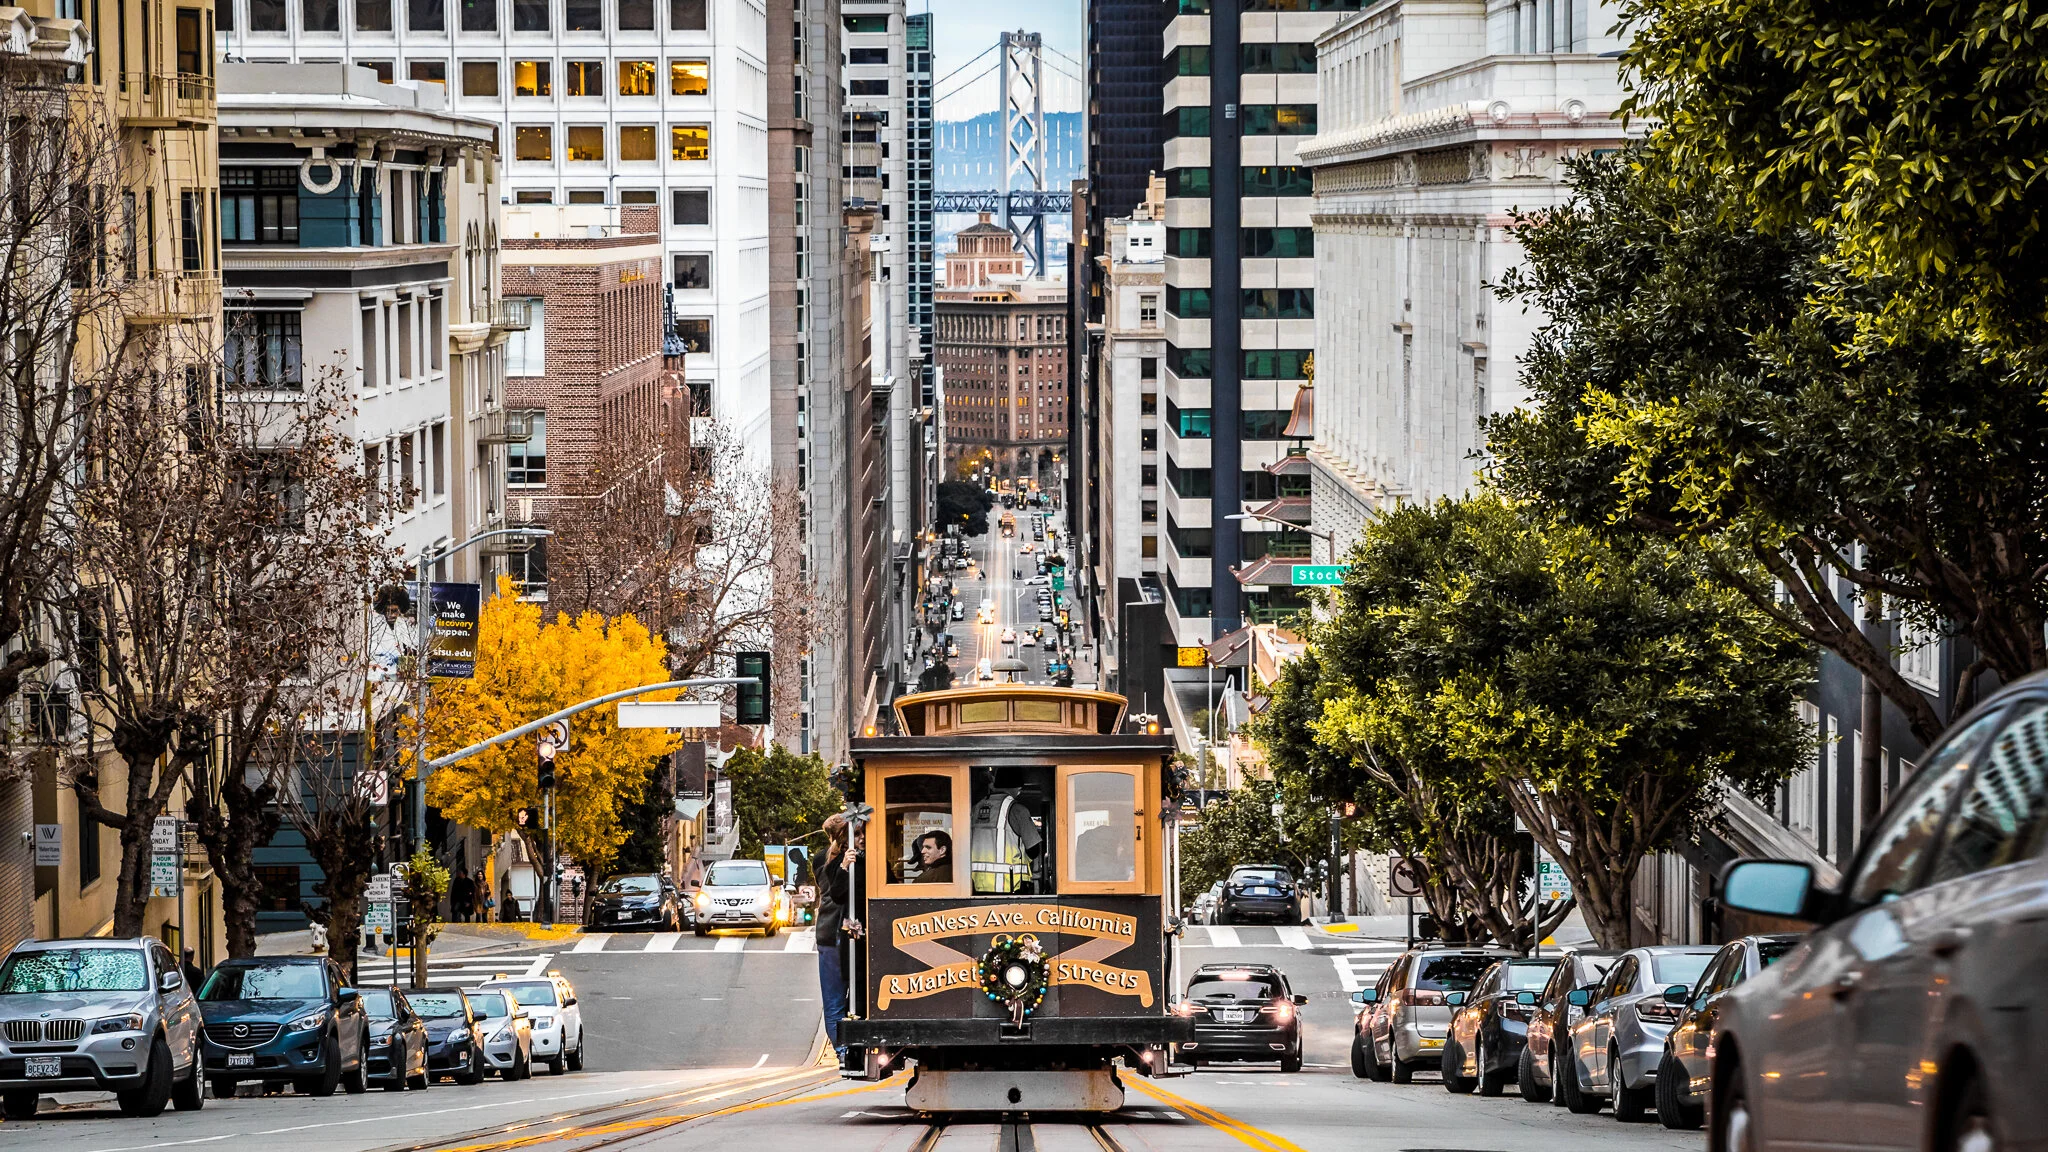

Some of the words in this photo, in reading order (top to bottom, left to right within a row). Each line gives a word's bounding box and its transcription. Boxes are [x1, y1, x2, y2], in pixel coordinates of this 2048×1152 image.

[446, 601, 461, 610] We
[441, 610, 465, 619] make
[435, 627, 470, 637] happen.
[1542, 864, 1547, 872] 2
[896, 920, 931, 938] Van
[932, 912, 979, 933] Ness
[1036, 908, 1134, 937] California
[889, 976, 904, 994] &
[907, 965, 977, 993] Market
[1057, 963, 1139, 990] Streets
